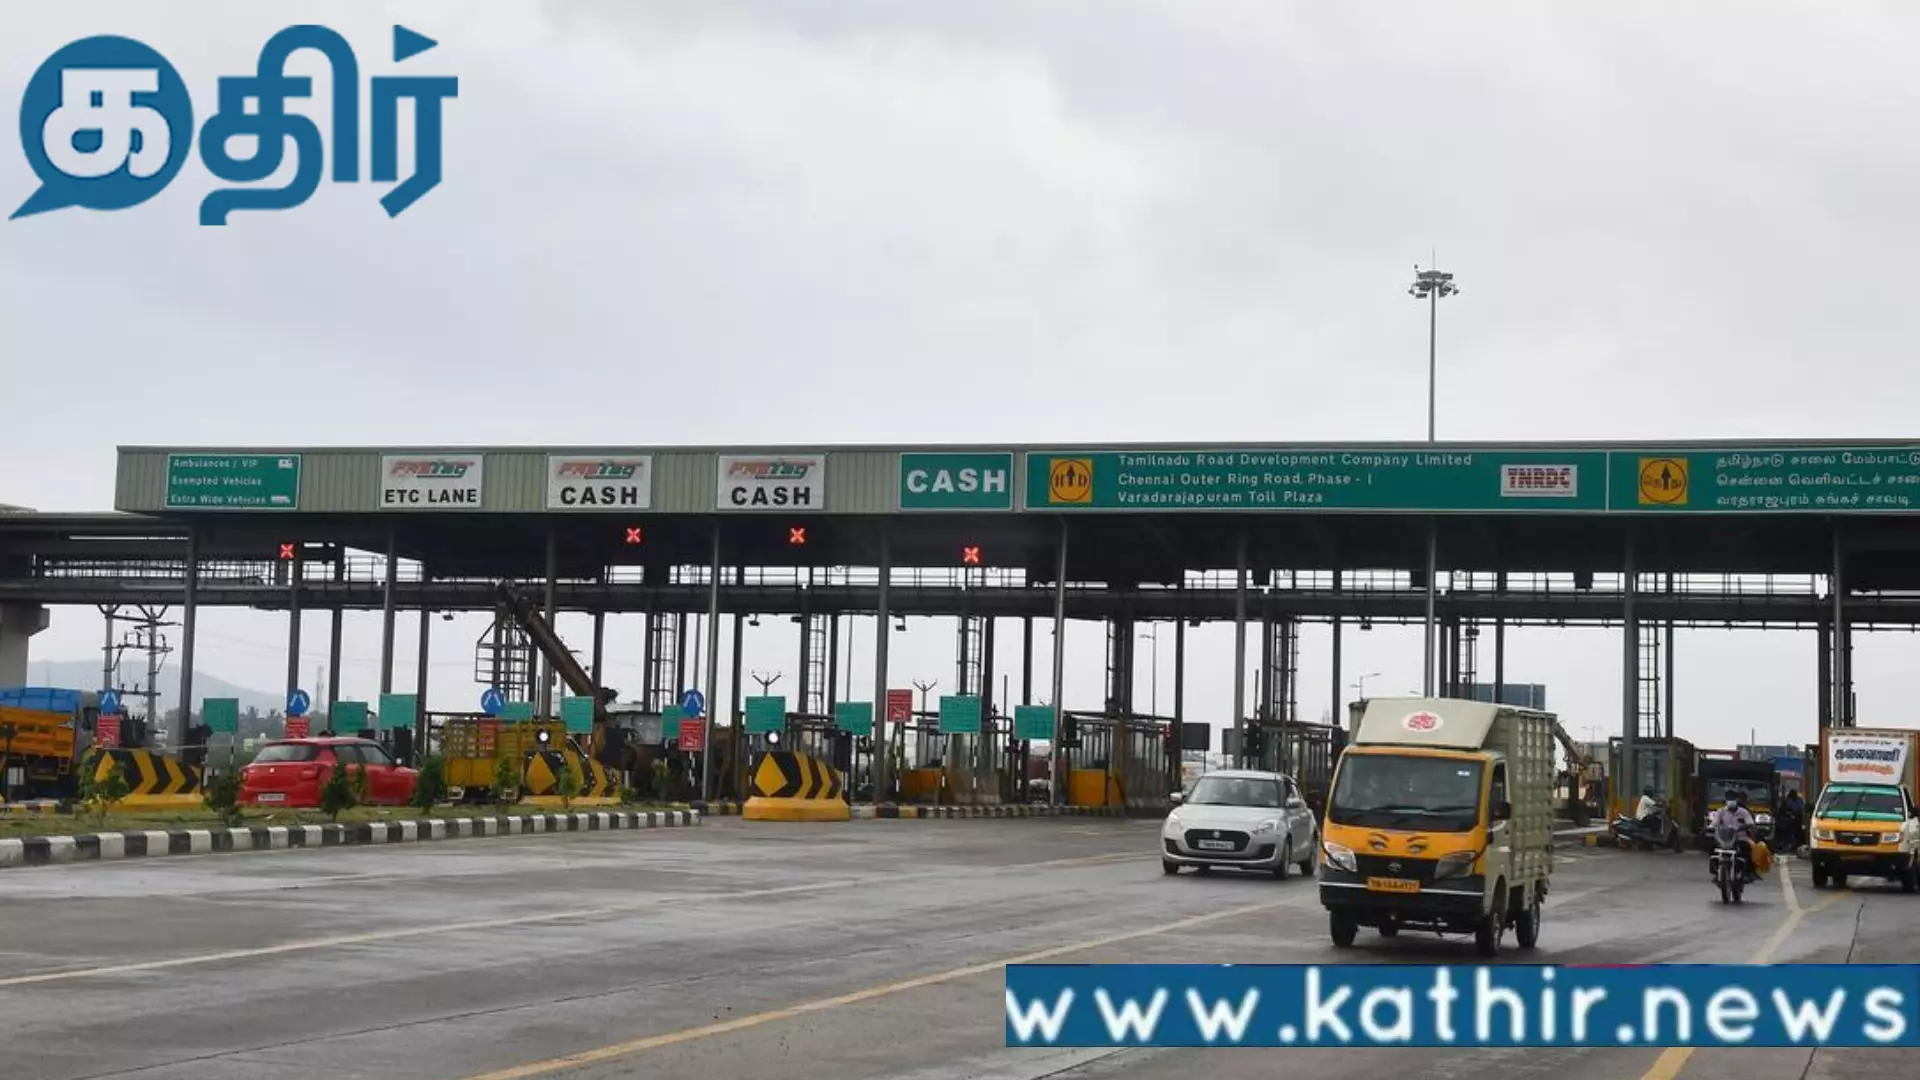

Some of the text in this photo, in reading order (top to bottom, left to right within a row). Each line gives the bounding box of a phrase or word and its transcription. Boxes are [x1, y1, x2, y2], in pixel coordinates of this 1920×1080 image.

[1118, 453, 1473, 468] Tamilnadu Road Development Company Limited
[1716, 453, 1785, 469] தமிழ்நாடு
[1790, 454, 1836, 466] சாலை
[906, 467, 1006, 493] CASH
[1118, 472, 1175, 485] Chennai
[1180, 472, 1221, 485] Outer
[1228, 472, 1259, 487] Ring
[1307, 472, 1352, 485] Phase
[1507, 467, 1572, 489] TNRDC
[1716, 472, 1784, 486] சென்னை
[1788, 472, 1882, 486] வெளிவட்டச்
[200, 494, 224, 504] Wide
[385, 488, 477, 504] ETC LANE
[560, 485, 638, 505] CASH
[731, 485, 811, 505] CASH
[1118, 490, 1323, 505] Varadarajapuram Toll Plaza
[1716, 492, 1810, 508] வரதராஜபுரம்
[1866, 494, 1910, 507] சாவடி
